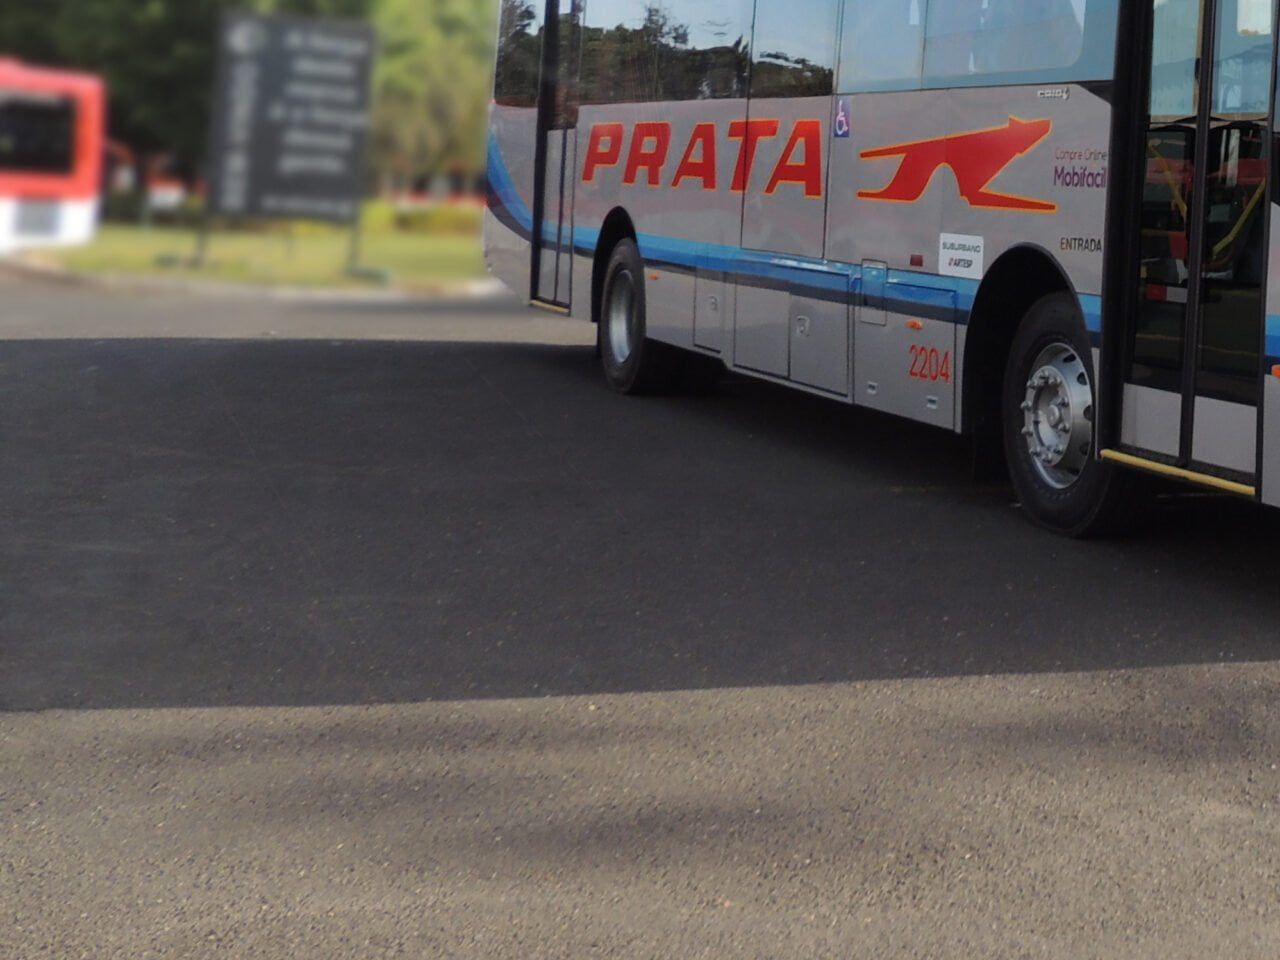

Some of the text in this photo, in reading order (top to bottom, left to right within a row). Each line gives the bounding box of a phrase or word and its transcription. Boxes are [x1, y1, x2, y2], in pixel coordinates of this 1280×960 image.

[581, 118, 823, 198] PRATA
[1060, 237, 1103, 251] ENTRADA
[909, 344, 950, 383] 2204
